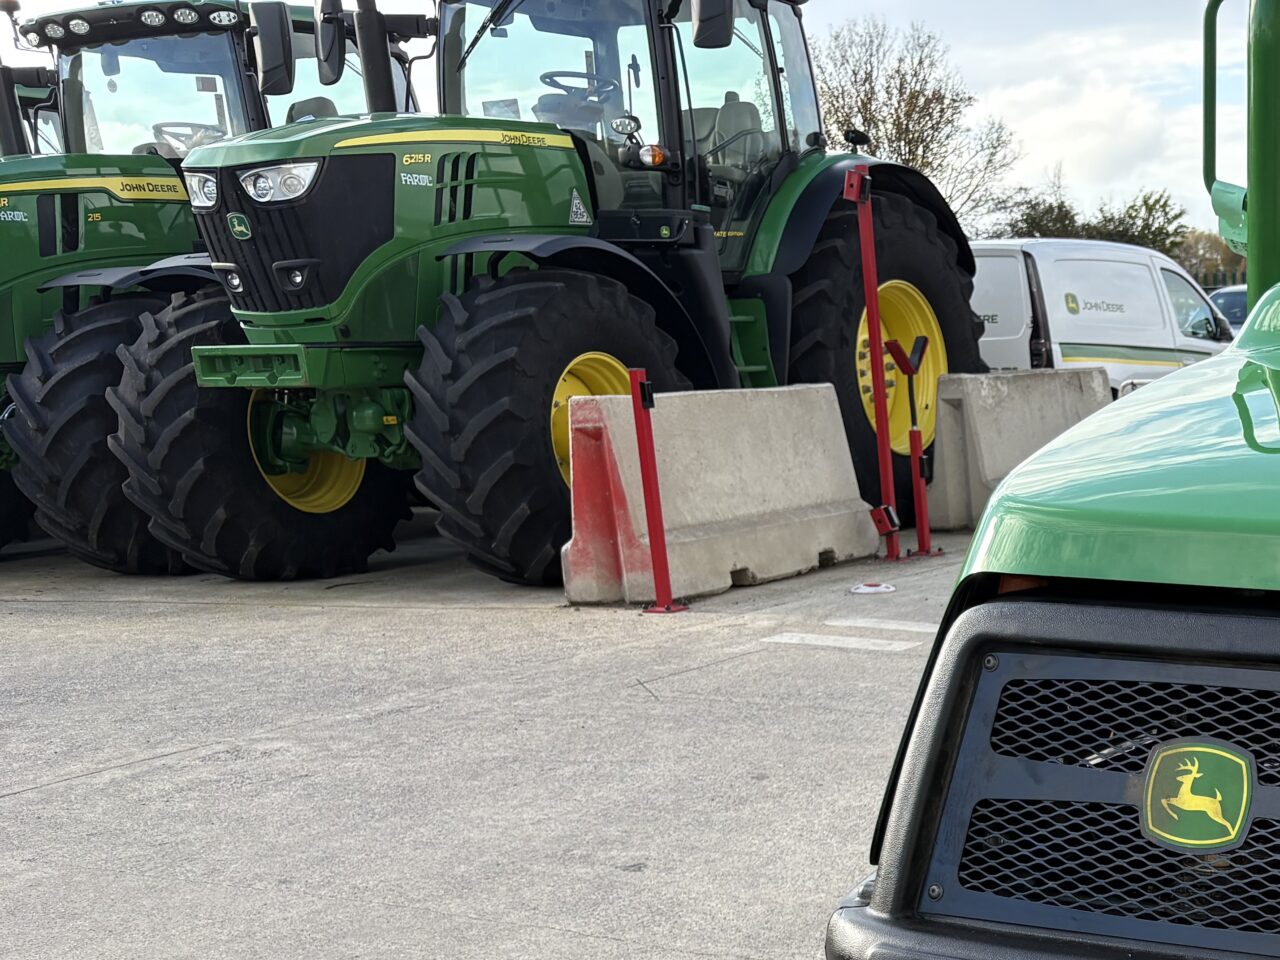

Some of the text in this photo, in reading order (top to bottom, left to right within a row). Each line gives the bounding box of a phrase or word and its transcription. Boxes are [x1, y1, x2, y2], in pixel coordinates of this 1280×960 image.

[501, 133, 546, 146] JOHN DEERE
[120, 182, 179, 193] JOHN DEERE
[0, 198, 8, 206] R
[0, 211, 28, 221] AROL
[87, 213, 101, 221] 215
[1082, 300, 1125, 313] JOHN DEERE
